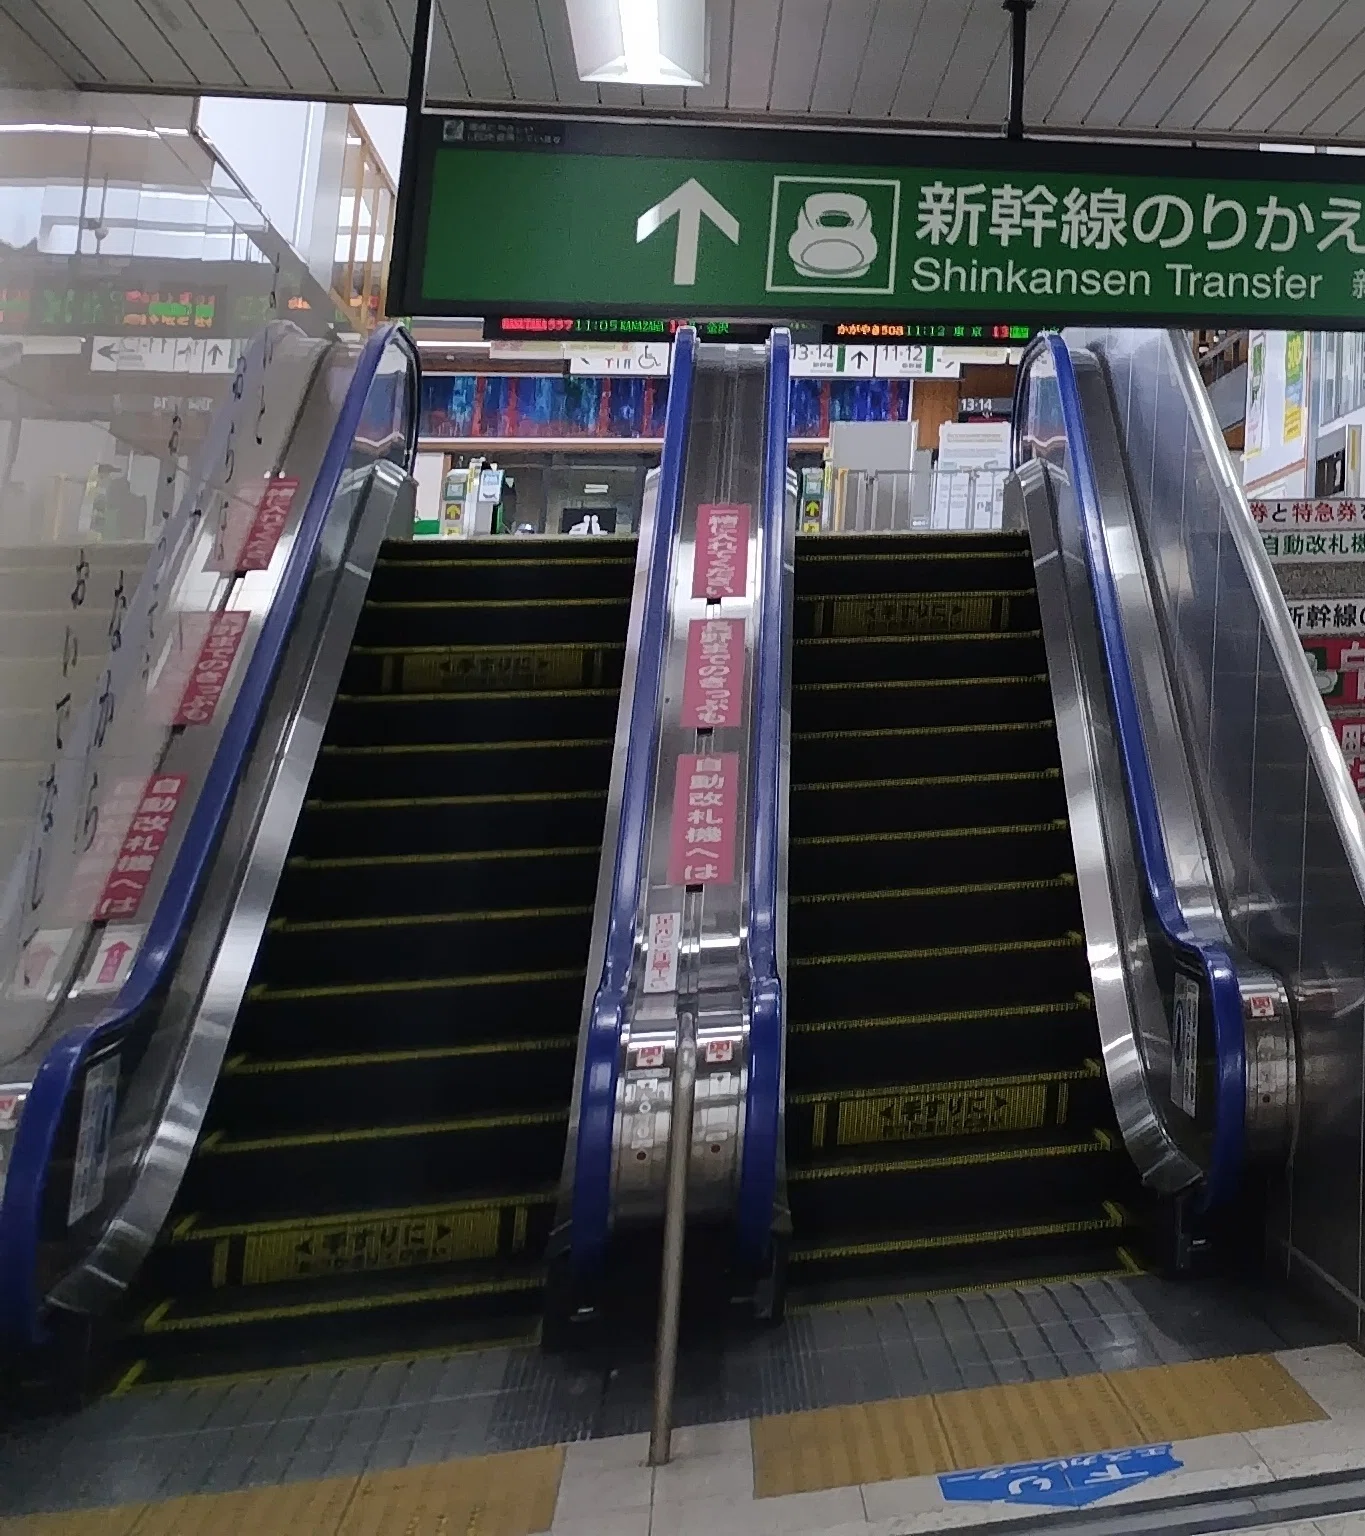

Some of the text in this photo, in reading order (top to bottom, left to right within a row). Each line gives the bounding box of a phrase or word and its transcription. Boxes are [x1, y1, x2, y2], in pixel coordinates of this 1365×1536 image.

[911, 256, 1323, 300] Shinkansen Transfer
[946, 1447, 1167, 1483] エスカレーター
